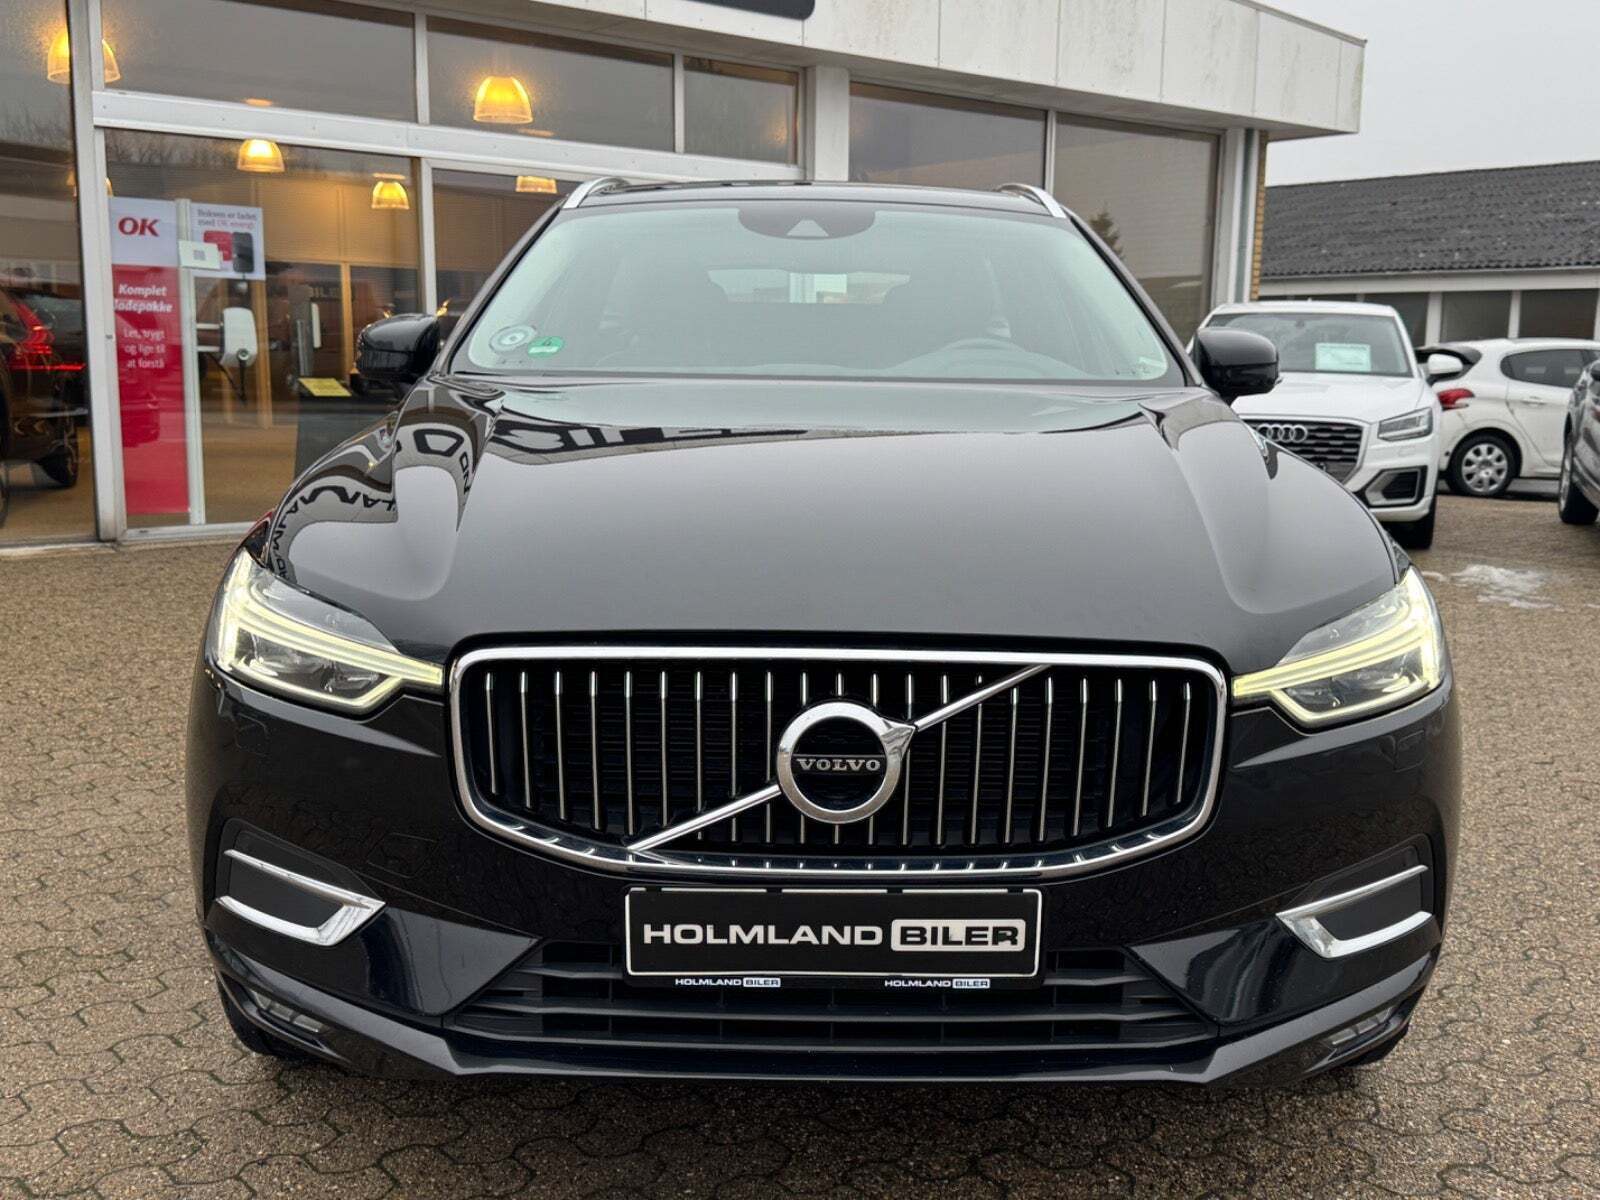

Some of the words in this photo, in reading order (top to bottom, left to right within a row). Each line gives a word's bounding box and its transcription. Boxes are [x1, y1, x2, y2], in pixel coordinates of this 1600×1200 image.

[118, 216, 160, 237] OK
[119, 284, 168, 298] Komplet
[124, 344, 138, 355] og
[127, 359, 137, 368] at
[797, 758, 880, 771] VOLVO
[643, 924, 883, 945] HOLMLAND
[901, 925, 1020, 947] BILER
[675, 978, 742, 986] HOLMLAND
[744, 979, 780, 987] BILER
[884, 979, 952, 988] HOLMLAND
[953, 980, 989, 988] BILER
